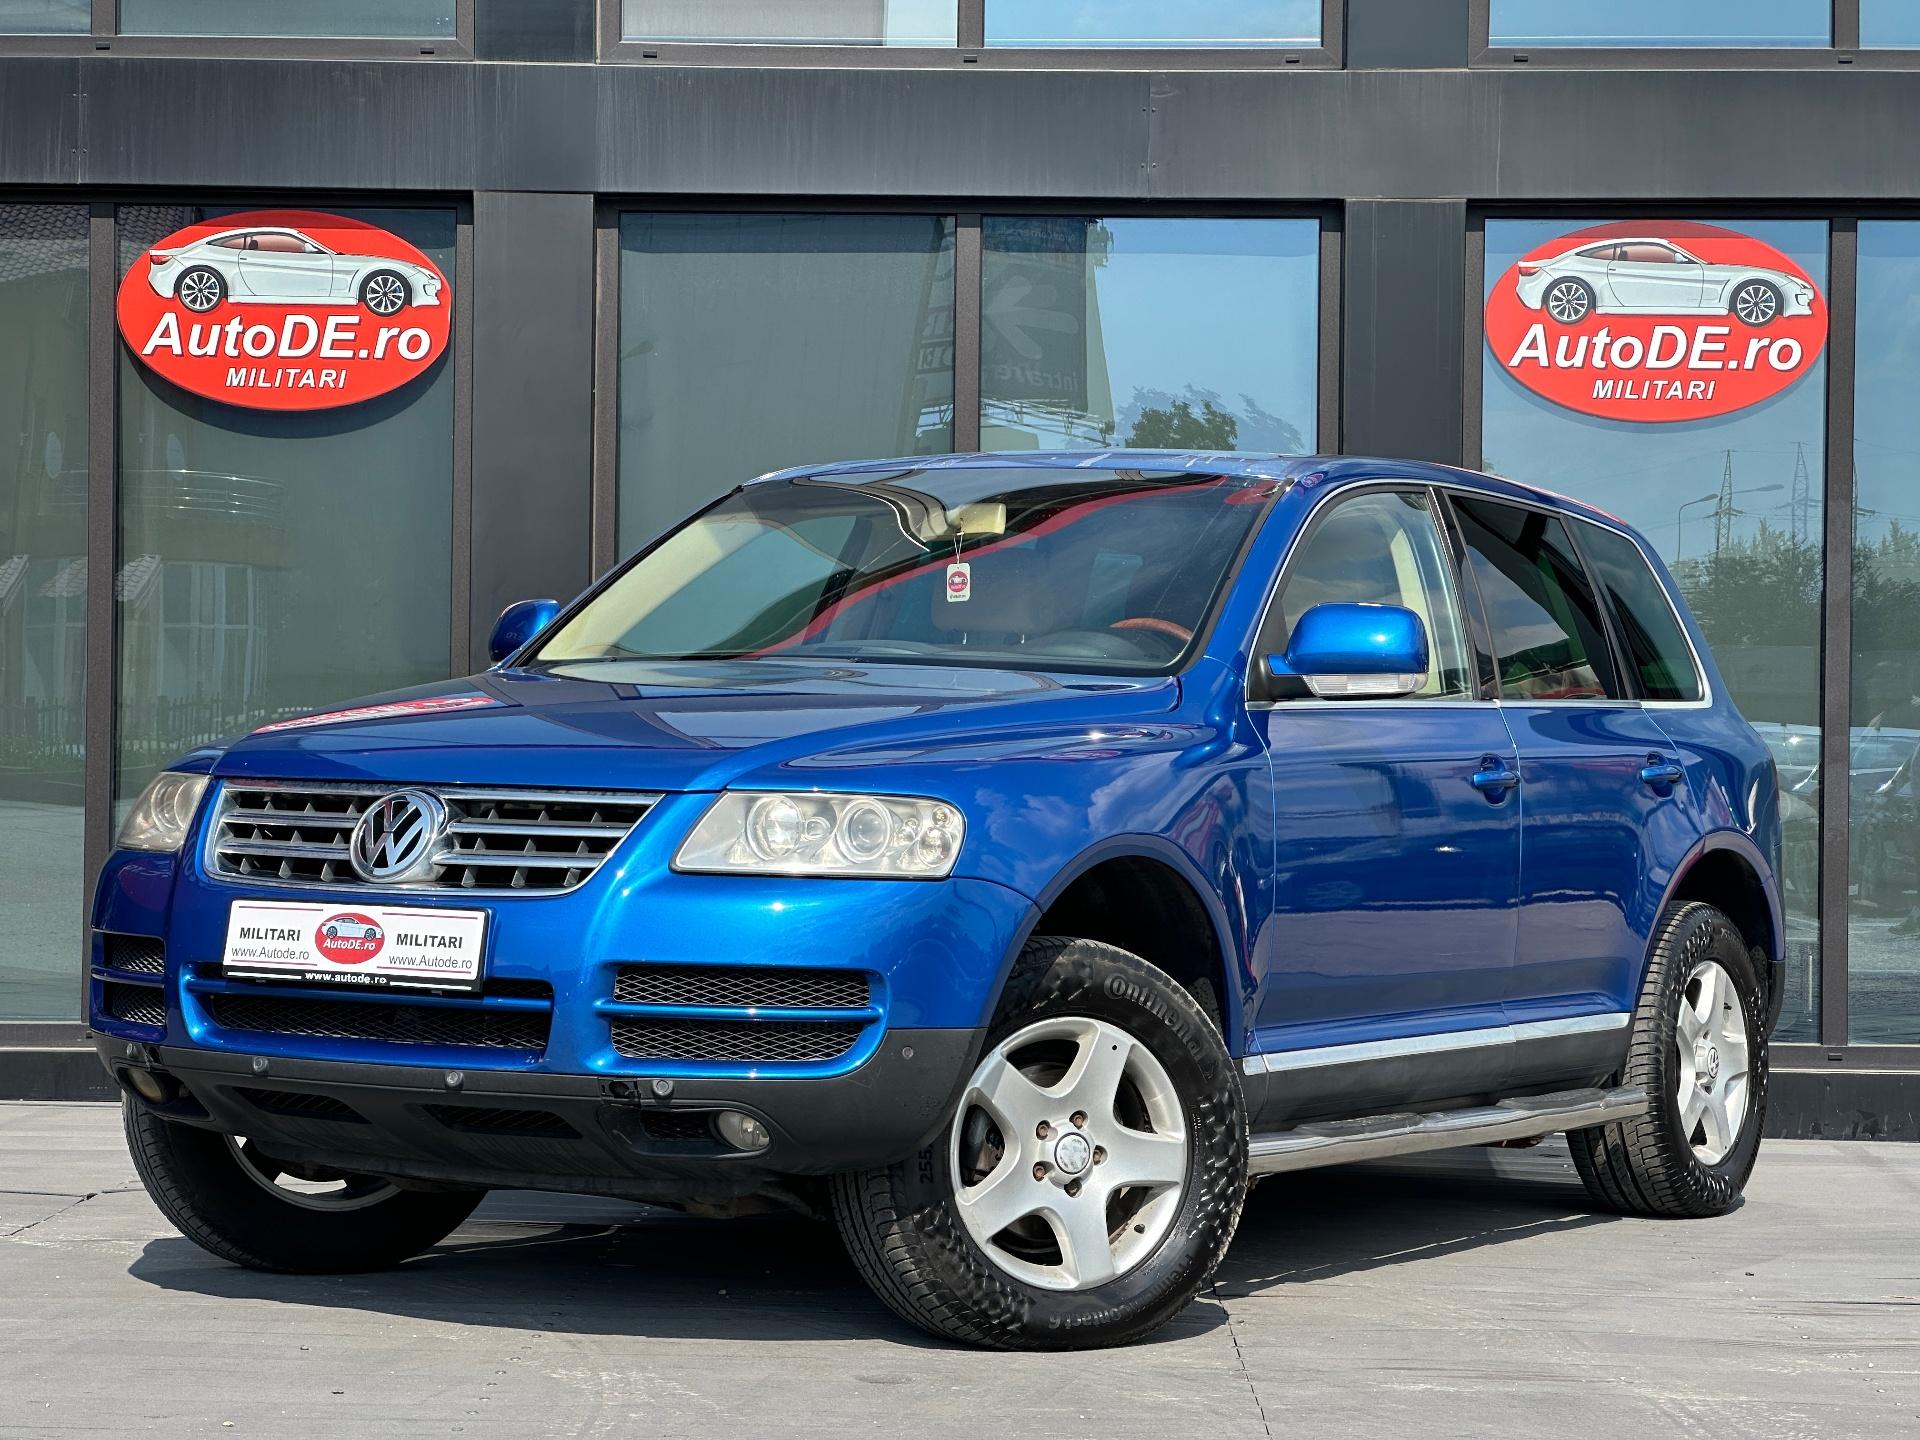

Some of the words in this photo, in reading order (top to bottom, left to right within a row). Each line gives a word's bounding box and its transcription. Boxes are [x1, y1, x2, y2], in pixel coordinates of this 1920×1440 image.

[142, 312, 432, 362] AutoDE.ro
[1508, 324, 1803, 371] AutoDE.ro
[226, 367, 347, 389] MILITARI
[1592, 379, 1716, 401] MILITARI
[239, 927, 301, 942] MILITARI
[396, 933, 463, 949] MILITARI
[322, 938, 376, 952] AutoDE.ro
[231, 946, 310, 961] www.Autode.ro
[388, 954, 473, 969] www.Autode.ro
[305, 972, 387, 985] www.autode.ro
